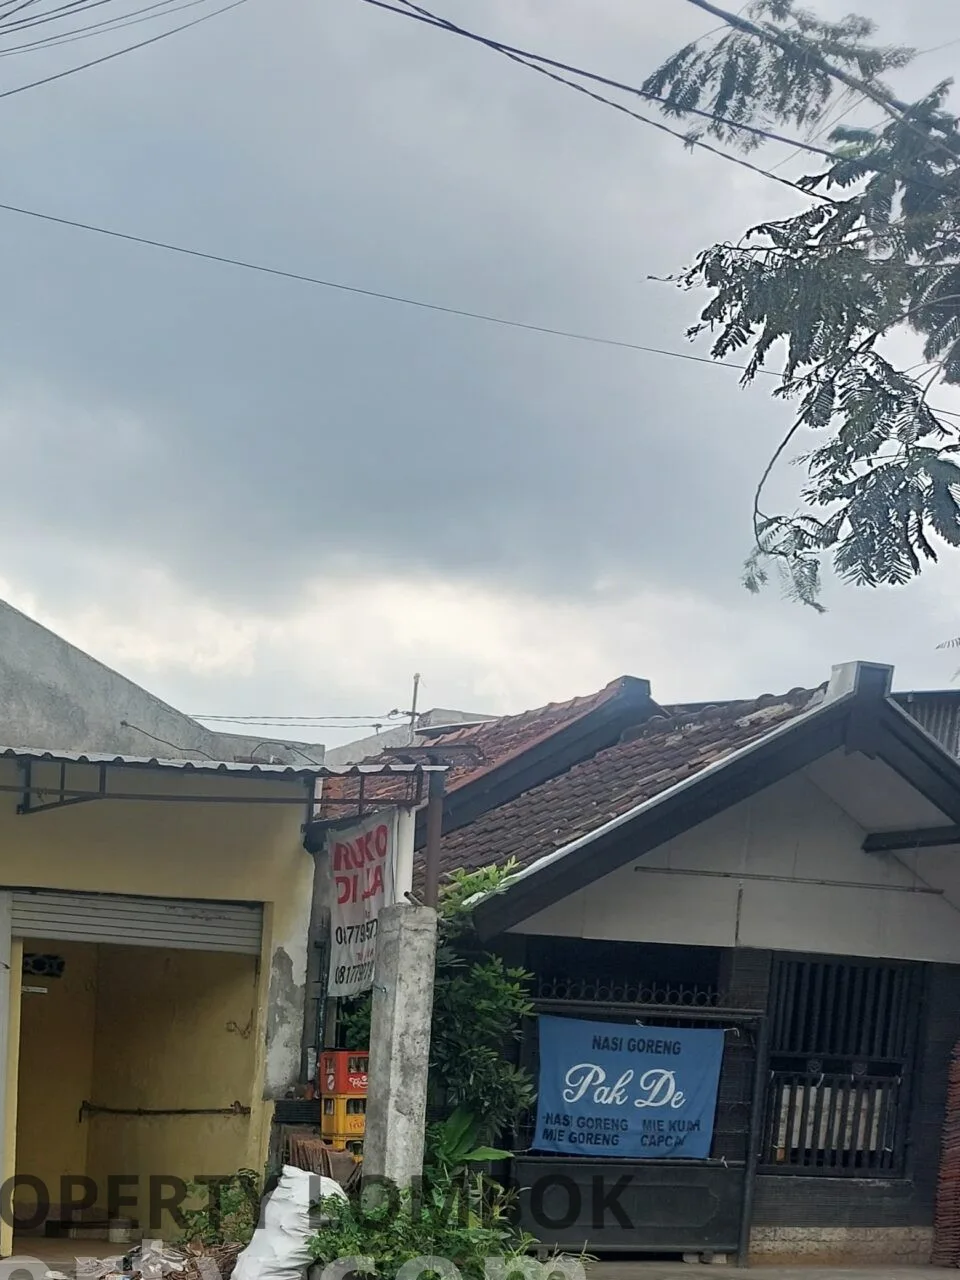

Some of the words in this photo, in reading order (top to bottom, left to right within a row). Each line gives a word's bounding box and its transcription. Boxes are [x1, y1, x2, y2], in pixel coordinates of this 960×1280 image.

[334, 825, 387, 871] RUKO
[592, 1035, 623, 1052] NASI
[627, 1038, 682, 1056] GORENG
[562, 1063, 634, 1105] Pak
[634, 1069, 687, 1109] De
[576, 1116, 628, 1131] GORENG
[642, 1119, 664, 1131] MIE
[542, 1128, 565, 1142] MIE
[568, 1131, 620, 1146] GORENG
